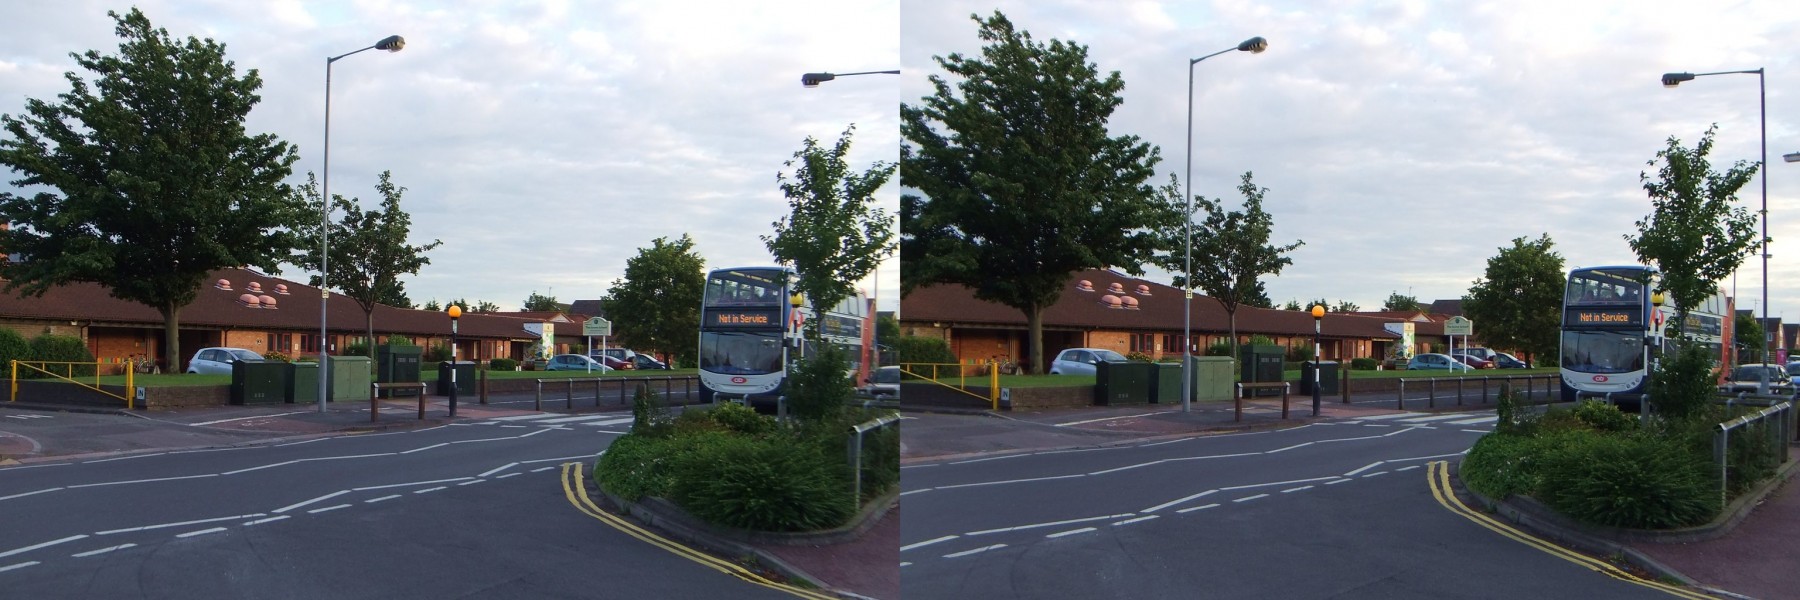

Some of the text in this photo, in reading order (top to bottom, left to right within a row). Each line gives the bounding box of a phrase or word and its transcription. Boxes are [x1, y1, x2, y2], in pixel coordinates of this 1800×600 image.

[719, 314, 768, 323] Not in Service
[1580, 313, 1629, 322] Not in Service
